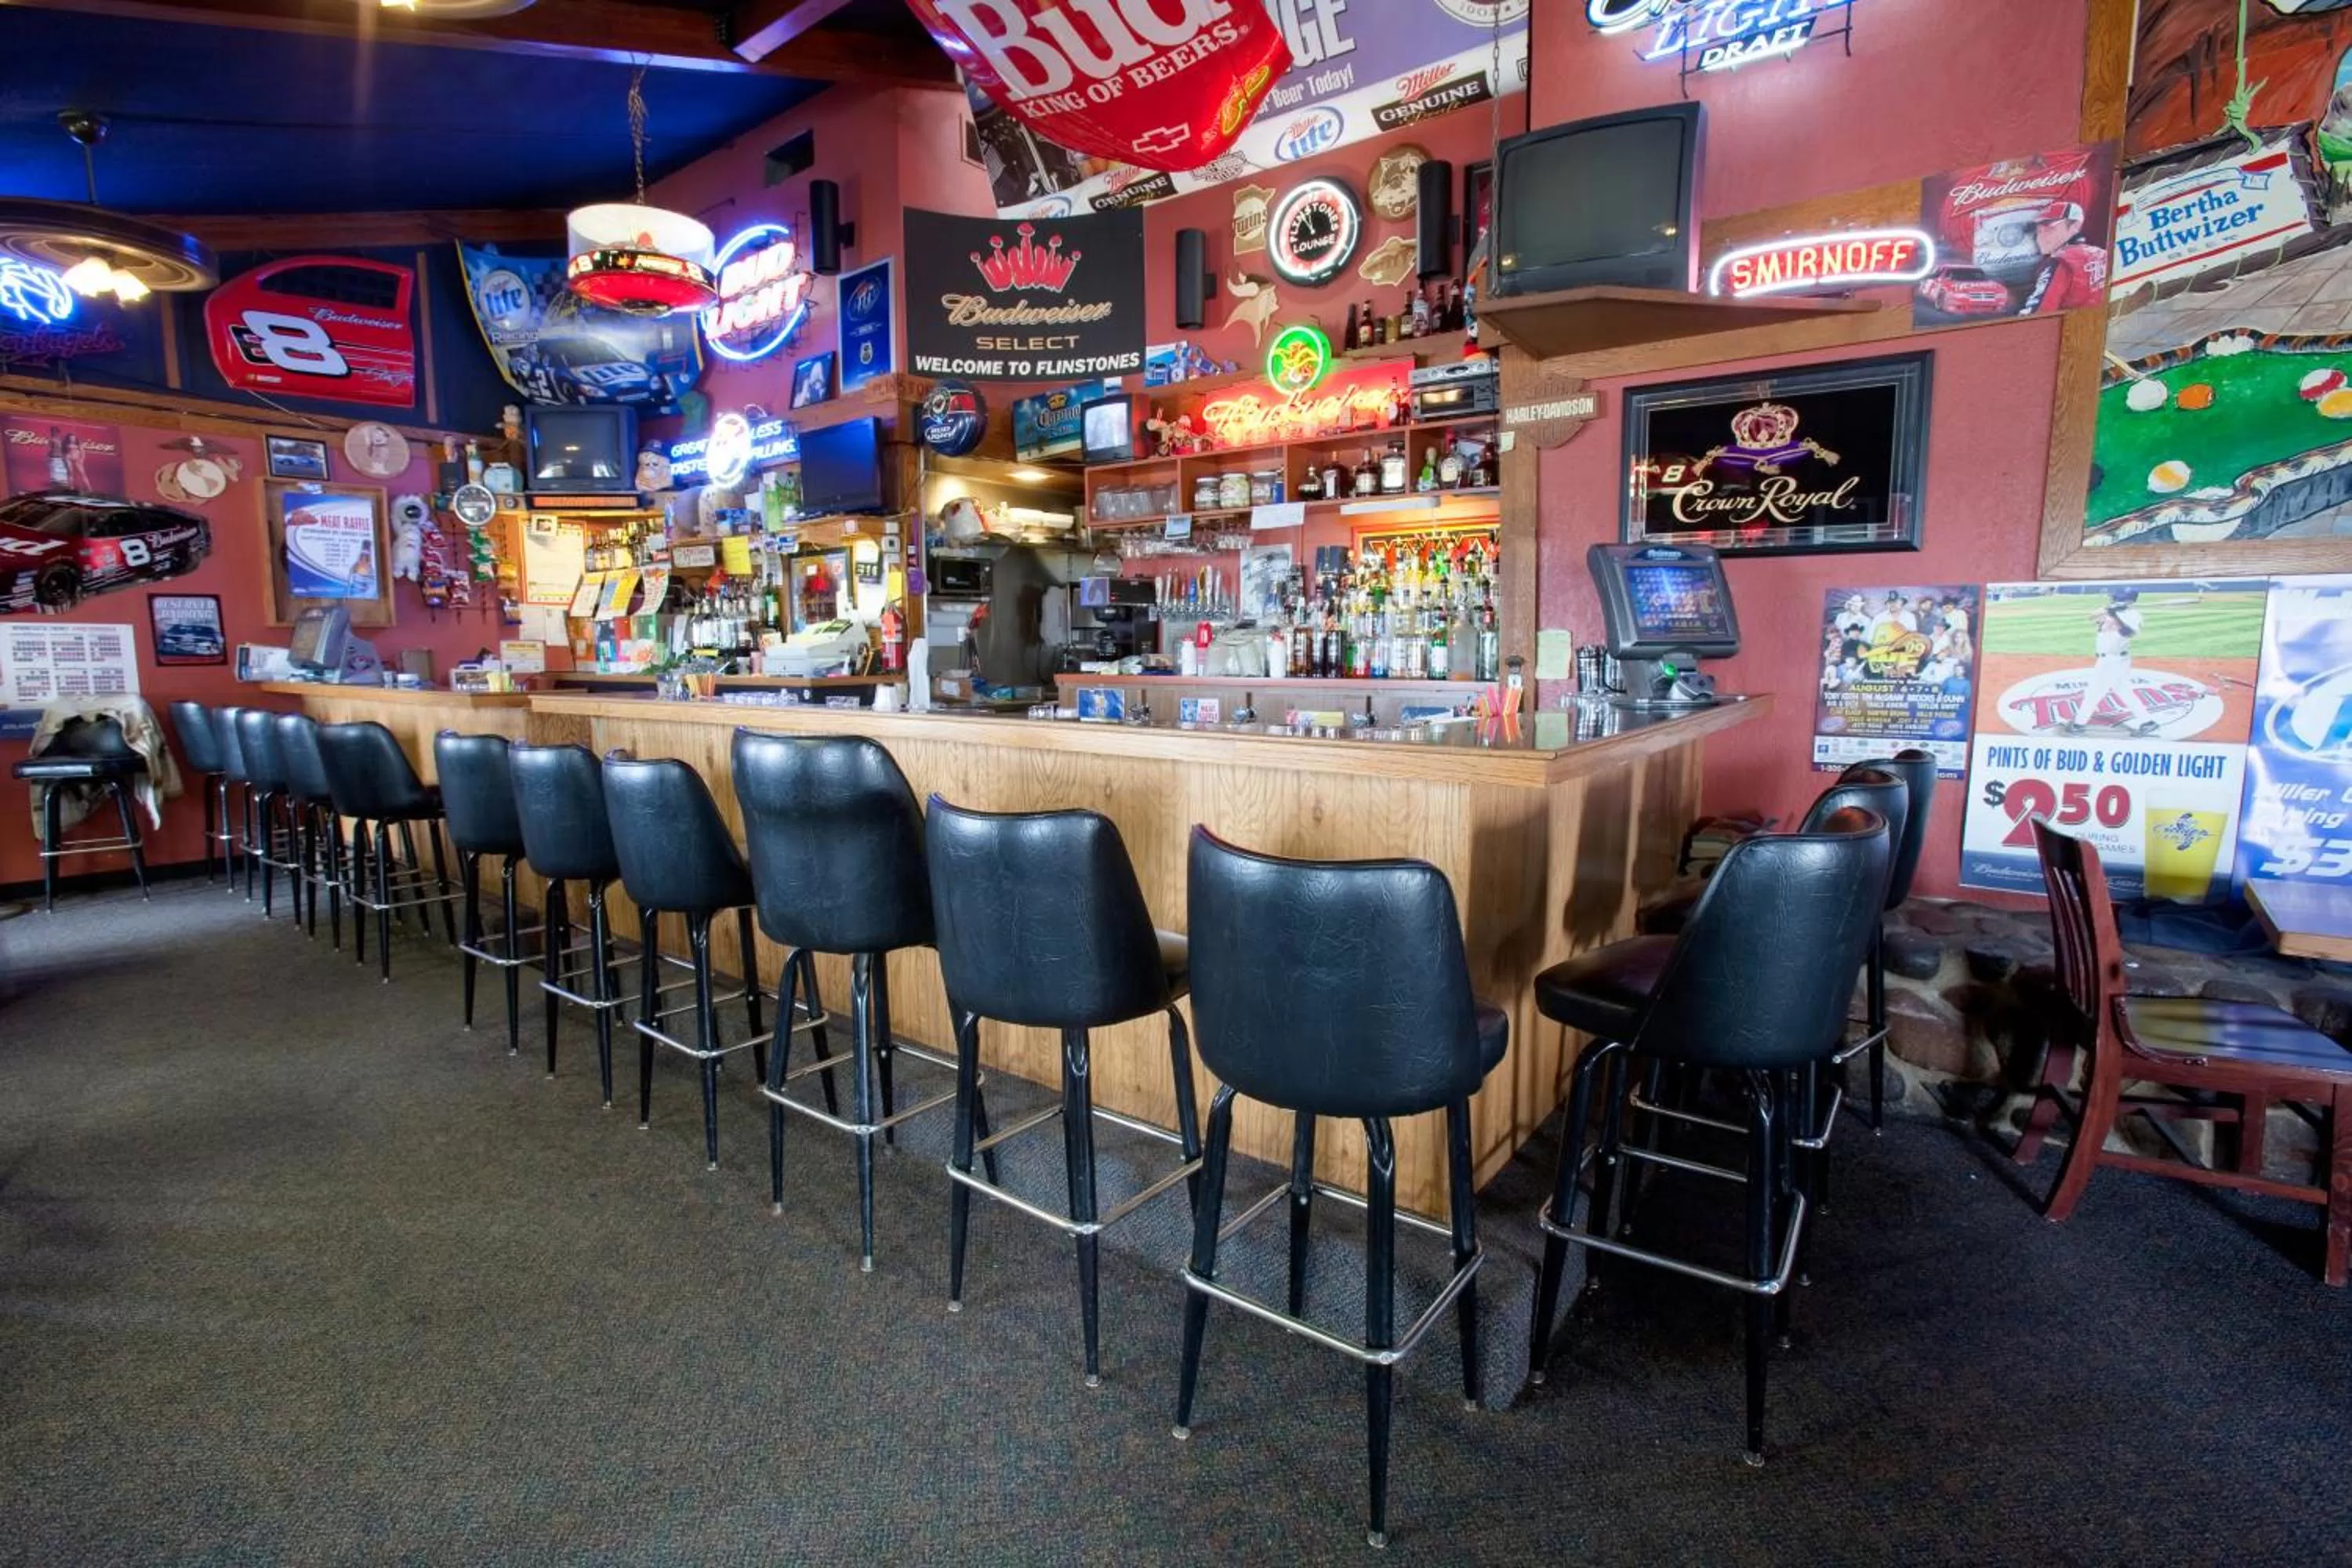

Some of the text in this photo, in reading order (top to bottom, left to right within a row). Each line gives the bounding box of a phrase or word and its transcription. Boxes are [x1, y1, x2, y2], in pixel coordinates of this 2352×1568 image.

[1701, 21, 1809, 68] DRAFT
[1018, 90, 1088, 118] KING
[1087, 76, 1123, 103] OF
[1272, 83, 1305, 109] Beer
[1306, 63, 1355, 95] Today!
[1379, 80, 1481, 123] GENUINE
[1396, 63, 1456, 103] Miller
[1094, 175, 1168, 210] GENUINE
[1949, 167, 2087, 207] Budweiser
[2147, 188, 2240, 231] Bertha
[1294, 233, 1336, 254] LOUNGE
[2117, 202, 2265, 268] Buttwizer
[1731, 239, 1915, 290] SMIRNOFF
[942, 293, 1112, 327] Budweiser
[241, 310, 350, 376] 8
[915, 351, 1141, 376] WELCOME TO FLINSTONES
[975, 335, 1080, 351] SELECT
[1672, 475, 1860, 524] Crown Royal
[120, 538, 151, 567] 8
[1987, 746, 2028, 770] PINTS
[2034, 749, 2052, 771] OF
[2056, 750, 2089, 773] BUD
[2093, 750, 2104, 773] &
[2111, 751, 2172, 777] GOLDEN
[2177, 753, 2227, 779] LIGHT
